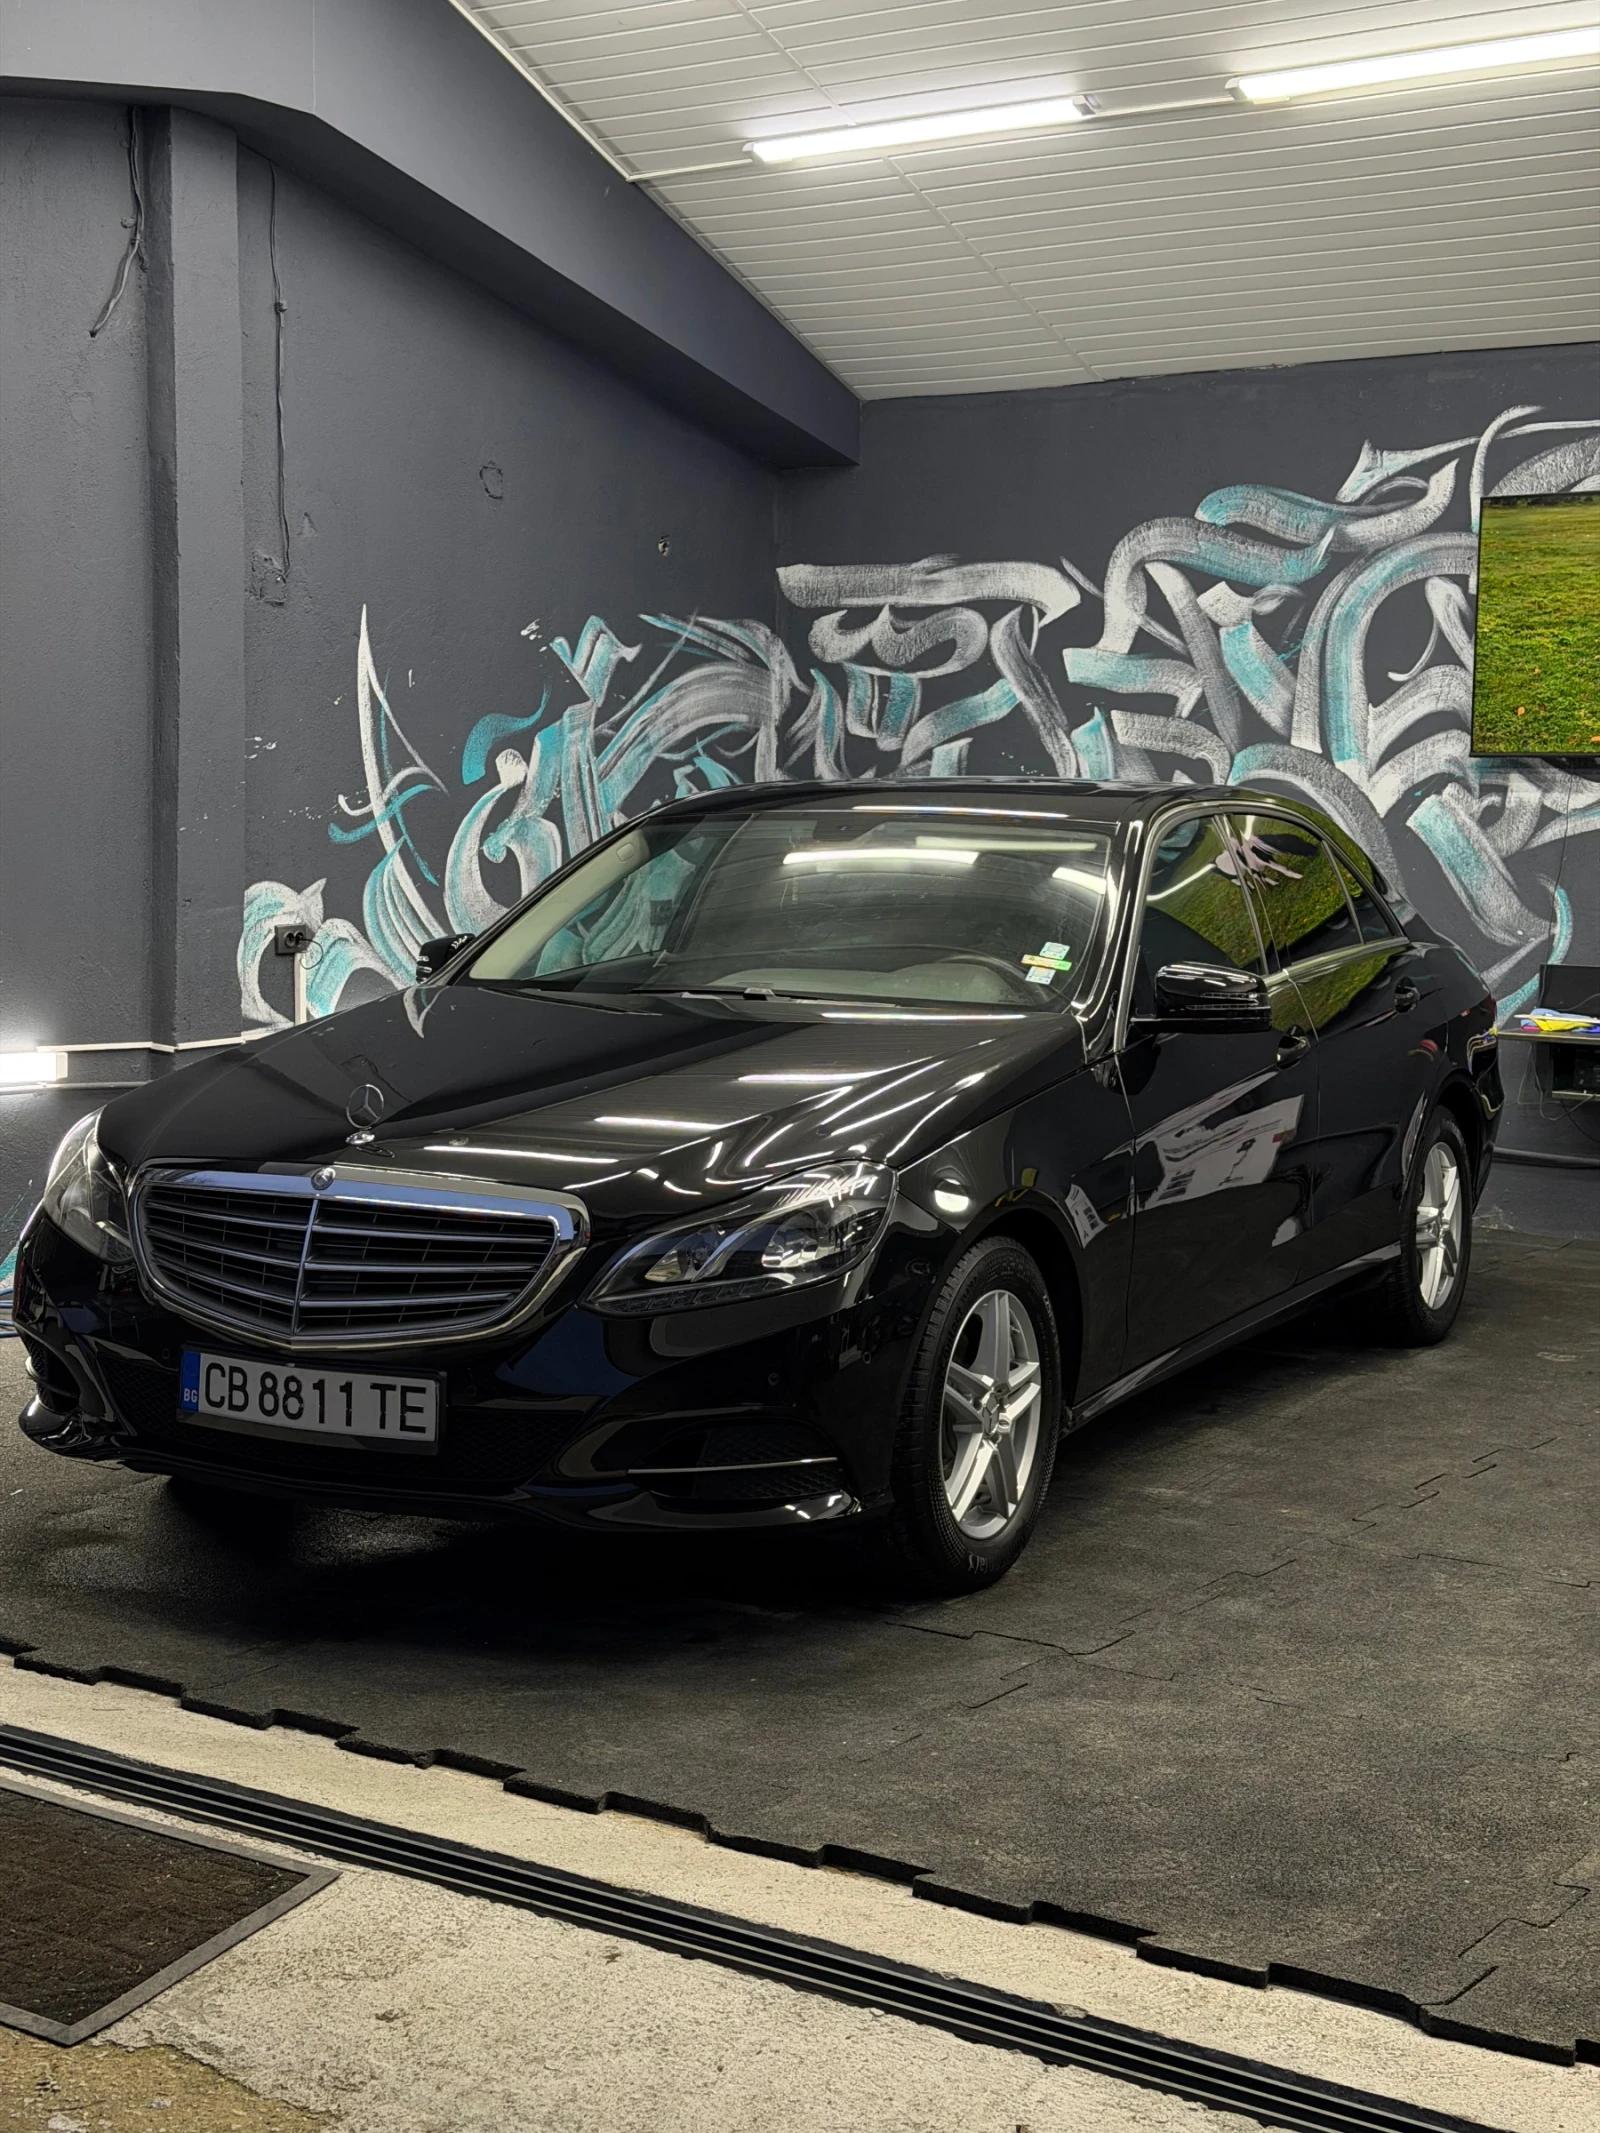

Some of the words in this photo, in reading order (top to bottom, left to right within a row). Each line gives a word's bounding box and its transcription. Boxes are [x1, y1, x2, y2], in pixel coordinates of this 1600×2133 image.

[183, 1388, 198, 1403] BG
[205, 1362, 249, 1412] CB
[258, 1371, 352, 1427] 8811
[370, 1382, 427, 1434] TE
